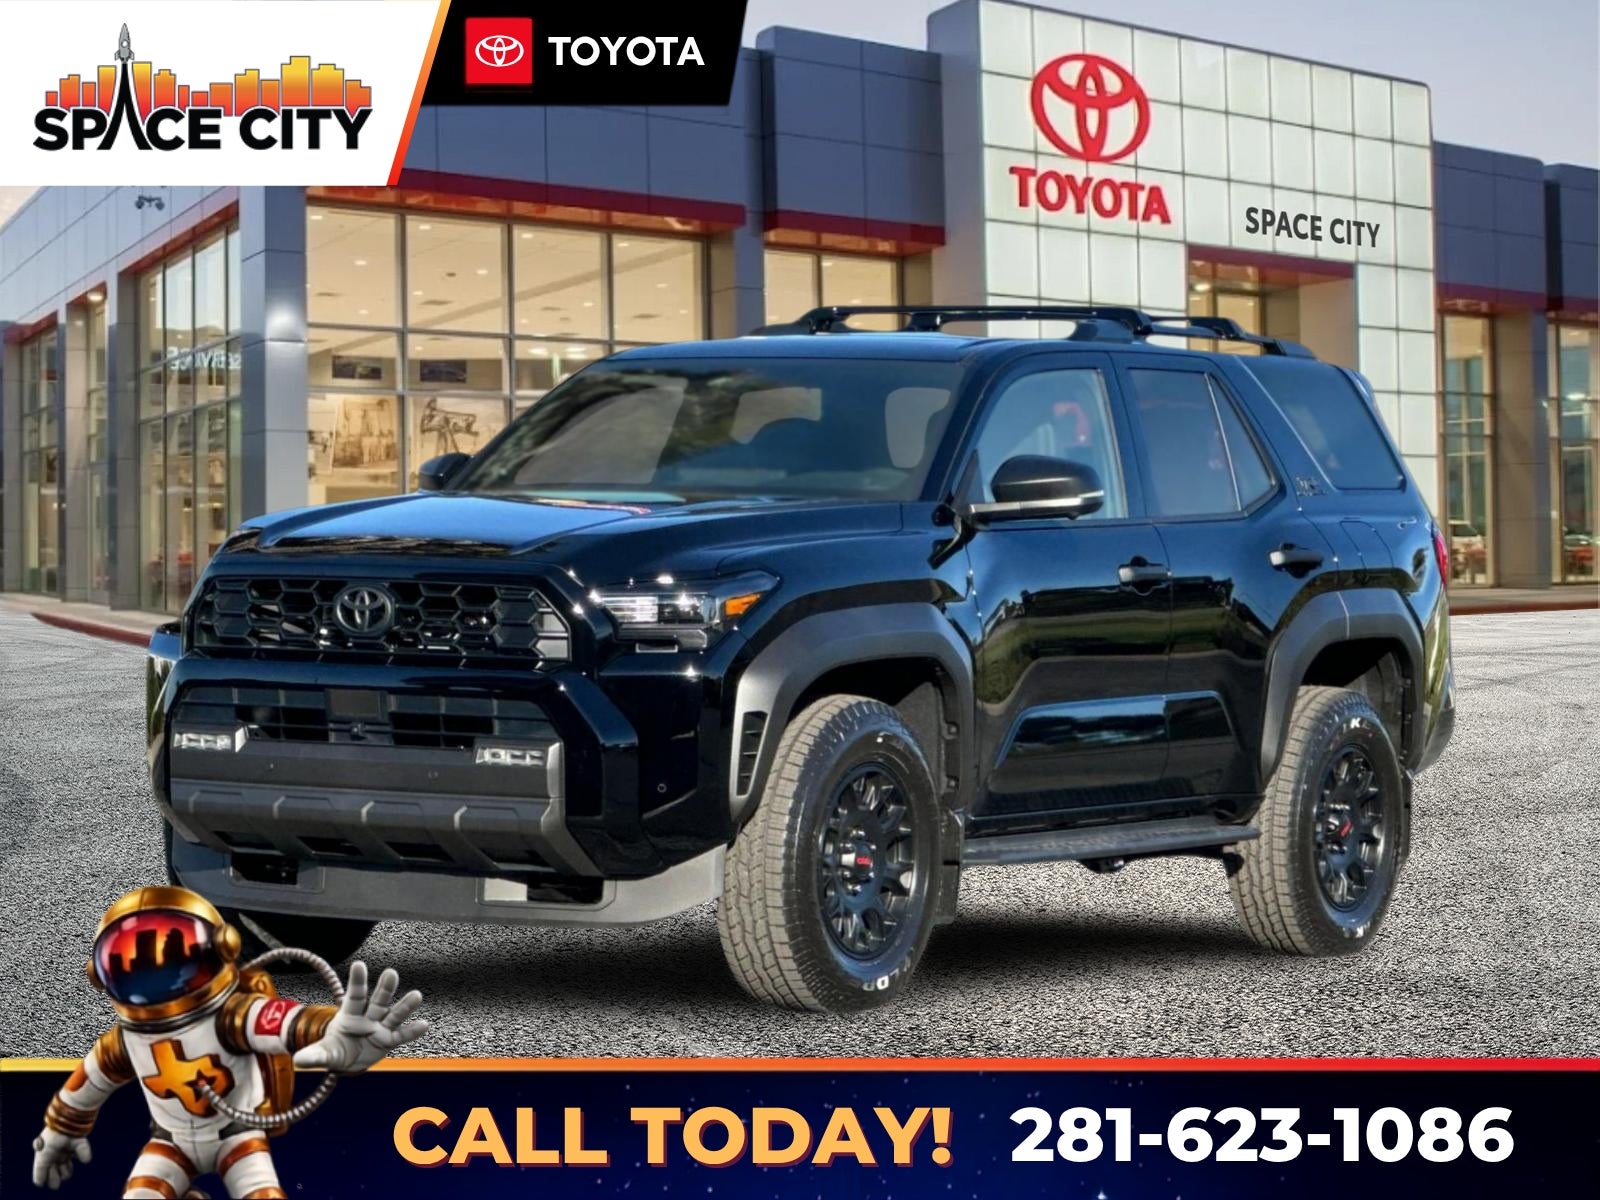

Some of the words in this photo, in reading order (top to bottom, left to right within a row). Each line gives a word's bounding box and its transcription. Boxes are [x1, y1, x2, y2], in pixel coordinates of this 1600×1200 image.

[1009, 166, 1171, 224] TOYOTA
[1245, 206, 1323, 242] SPACE
[1329, 217, 1381, 248] CITY
